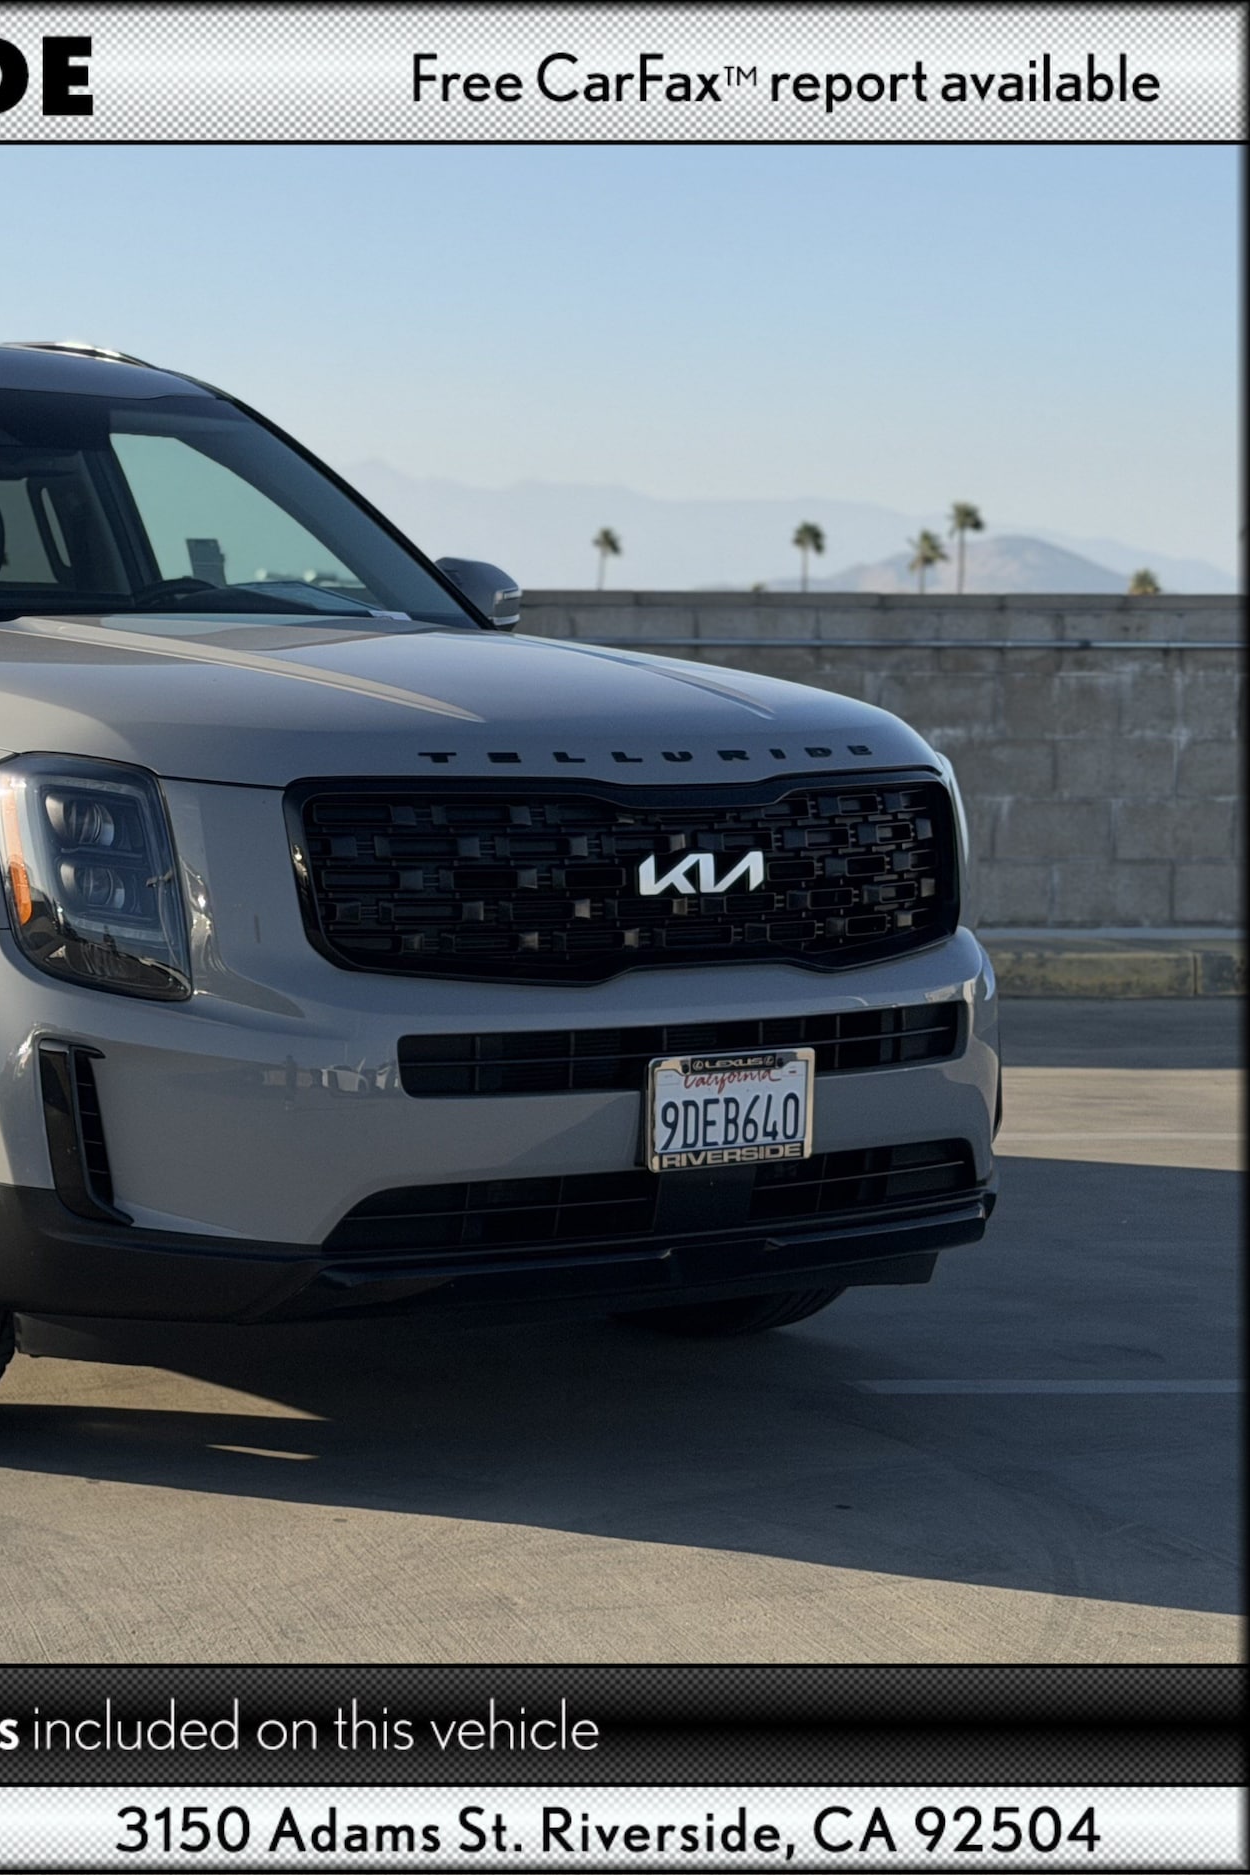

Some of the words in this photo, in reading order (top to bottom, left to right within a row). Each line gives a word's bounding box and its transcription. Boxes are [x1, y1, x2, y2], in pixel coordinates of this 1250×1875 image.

[417, 744, 873, 764] TELLURIDE
[704, 1057, 764, 1069] LEXUS
[683, 1068, 782, 1094] California
[661, 1092, 800, 1151] 9DEB640
[662, 1143, 801, 1168] RIVERSIDE
